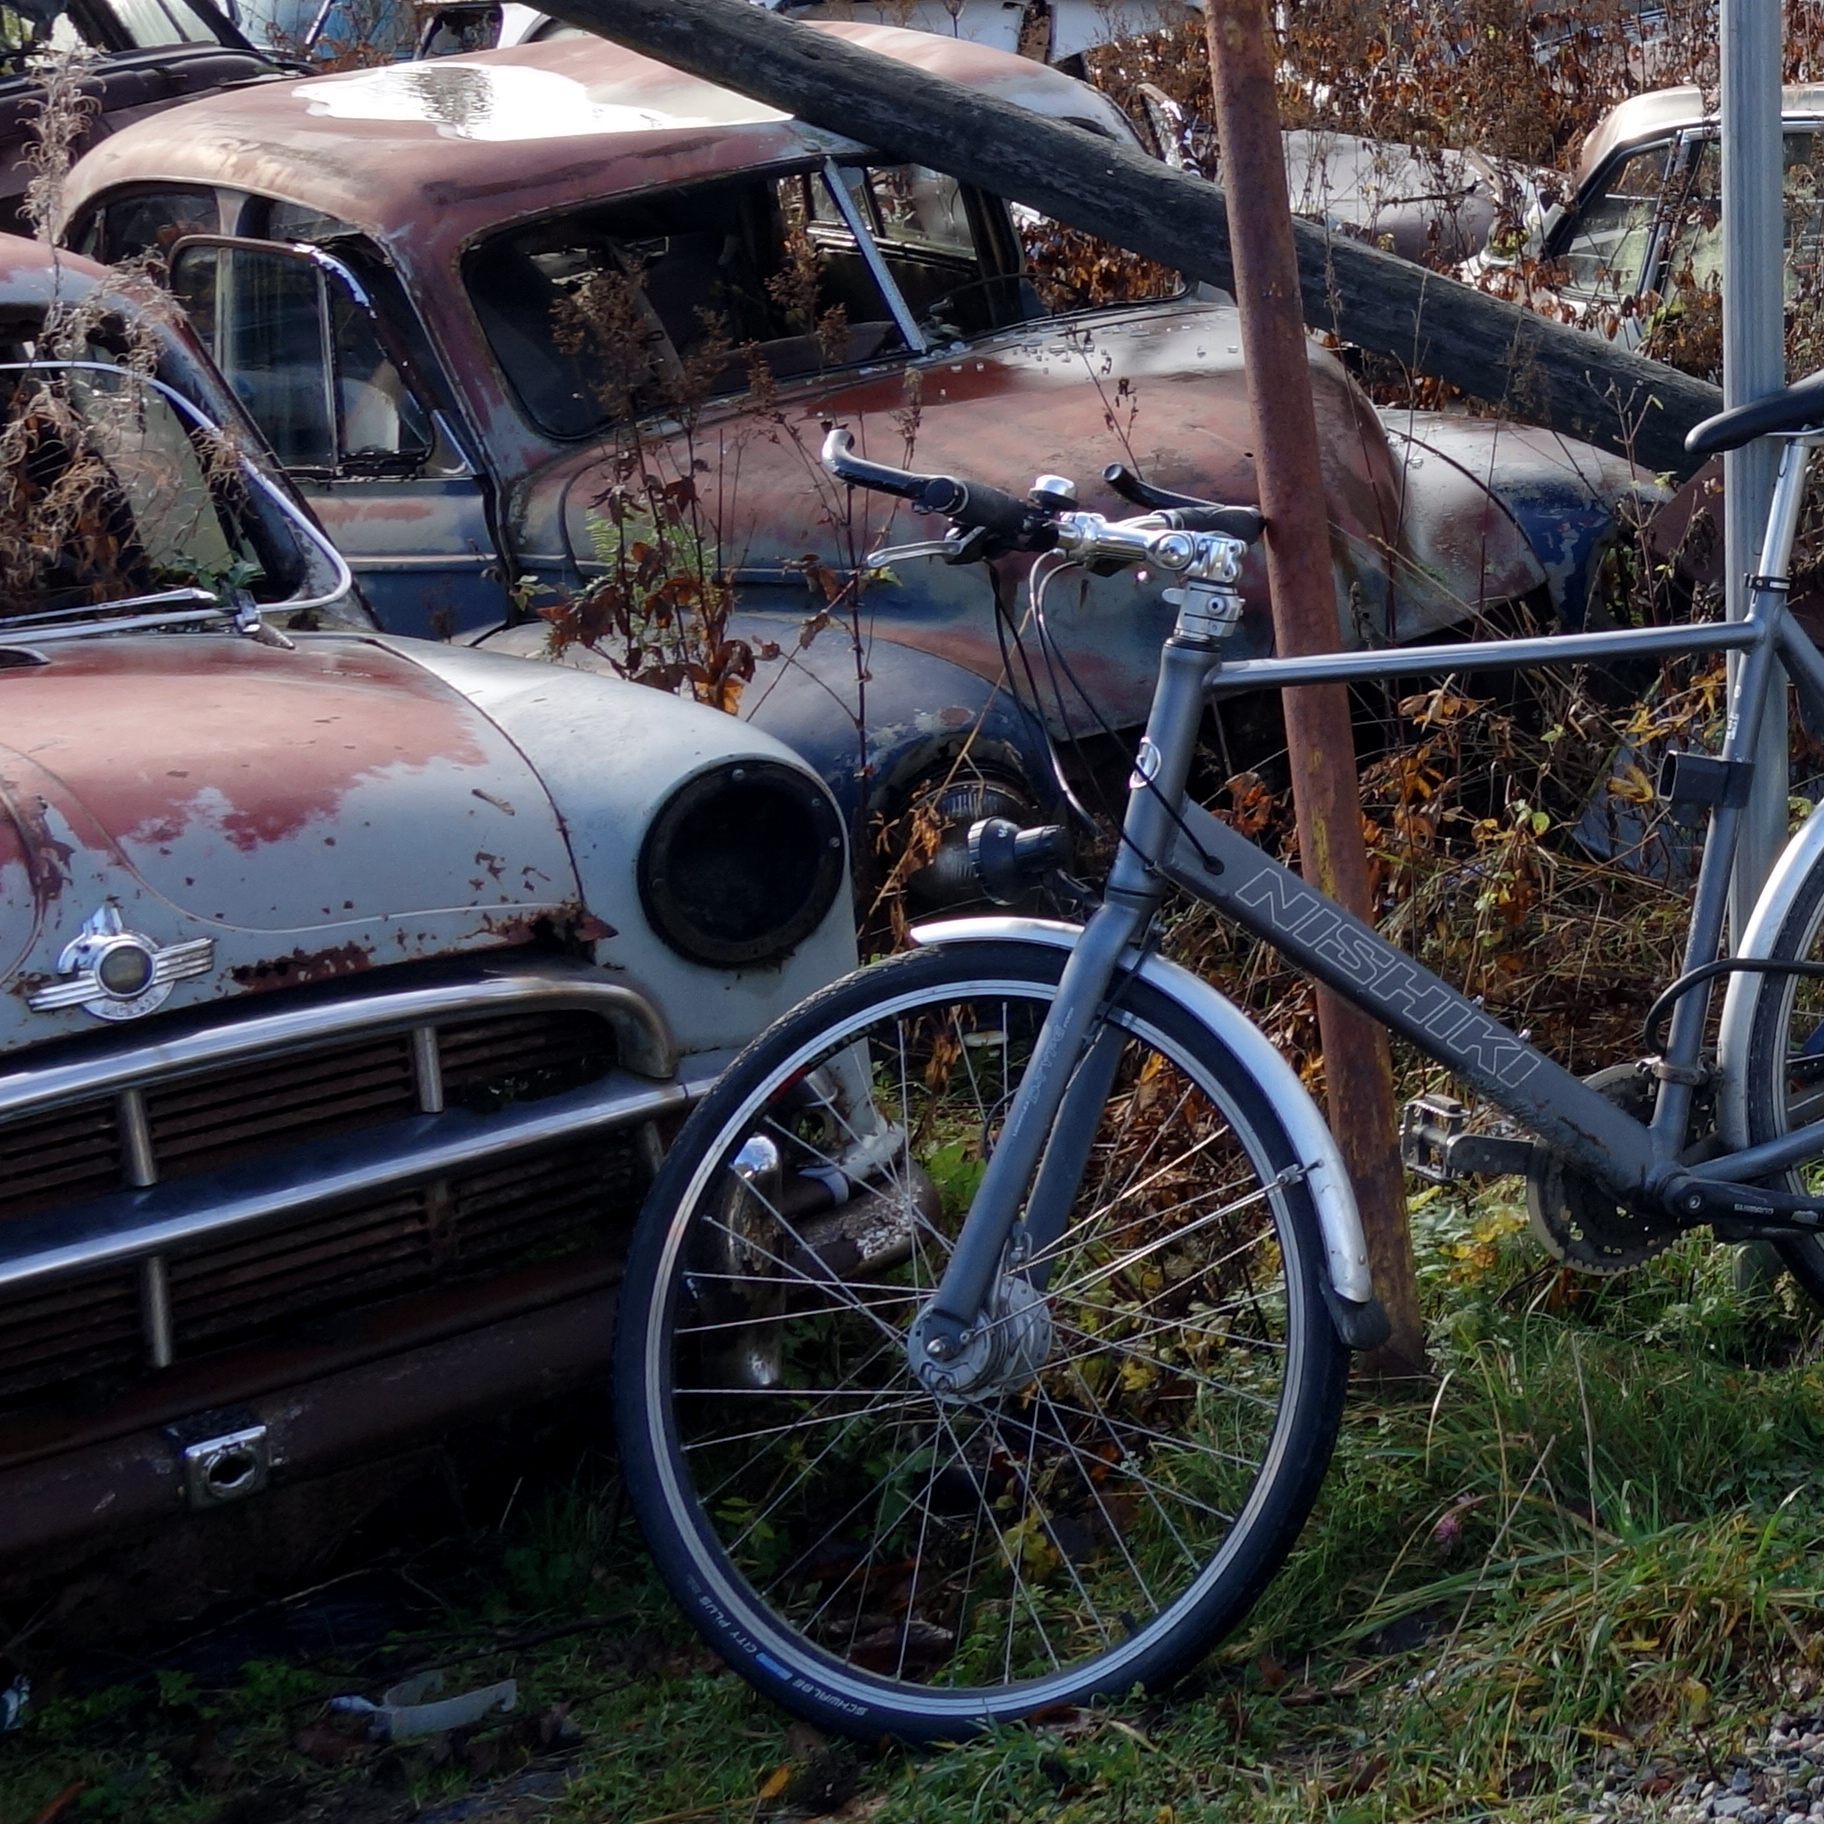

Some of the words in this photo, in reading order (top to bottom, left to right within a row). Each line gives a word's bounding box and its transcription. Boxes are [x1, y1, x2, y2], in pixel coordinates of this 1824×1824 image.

[1235, 867, 1541, 1088] NISHIKI
[700, 1595, 732, 1629] PLUS
[728, 1630, 758, 1655] CITY
[792, 1677, 869, 1717] SCHWALBE
